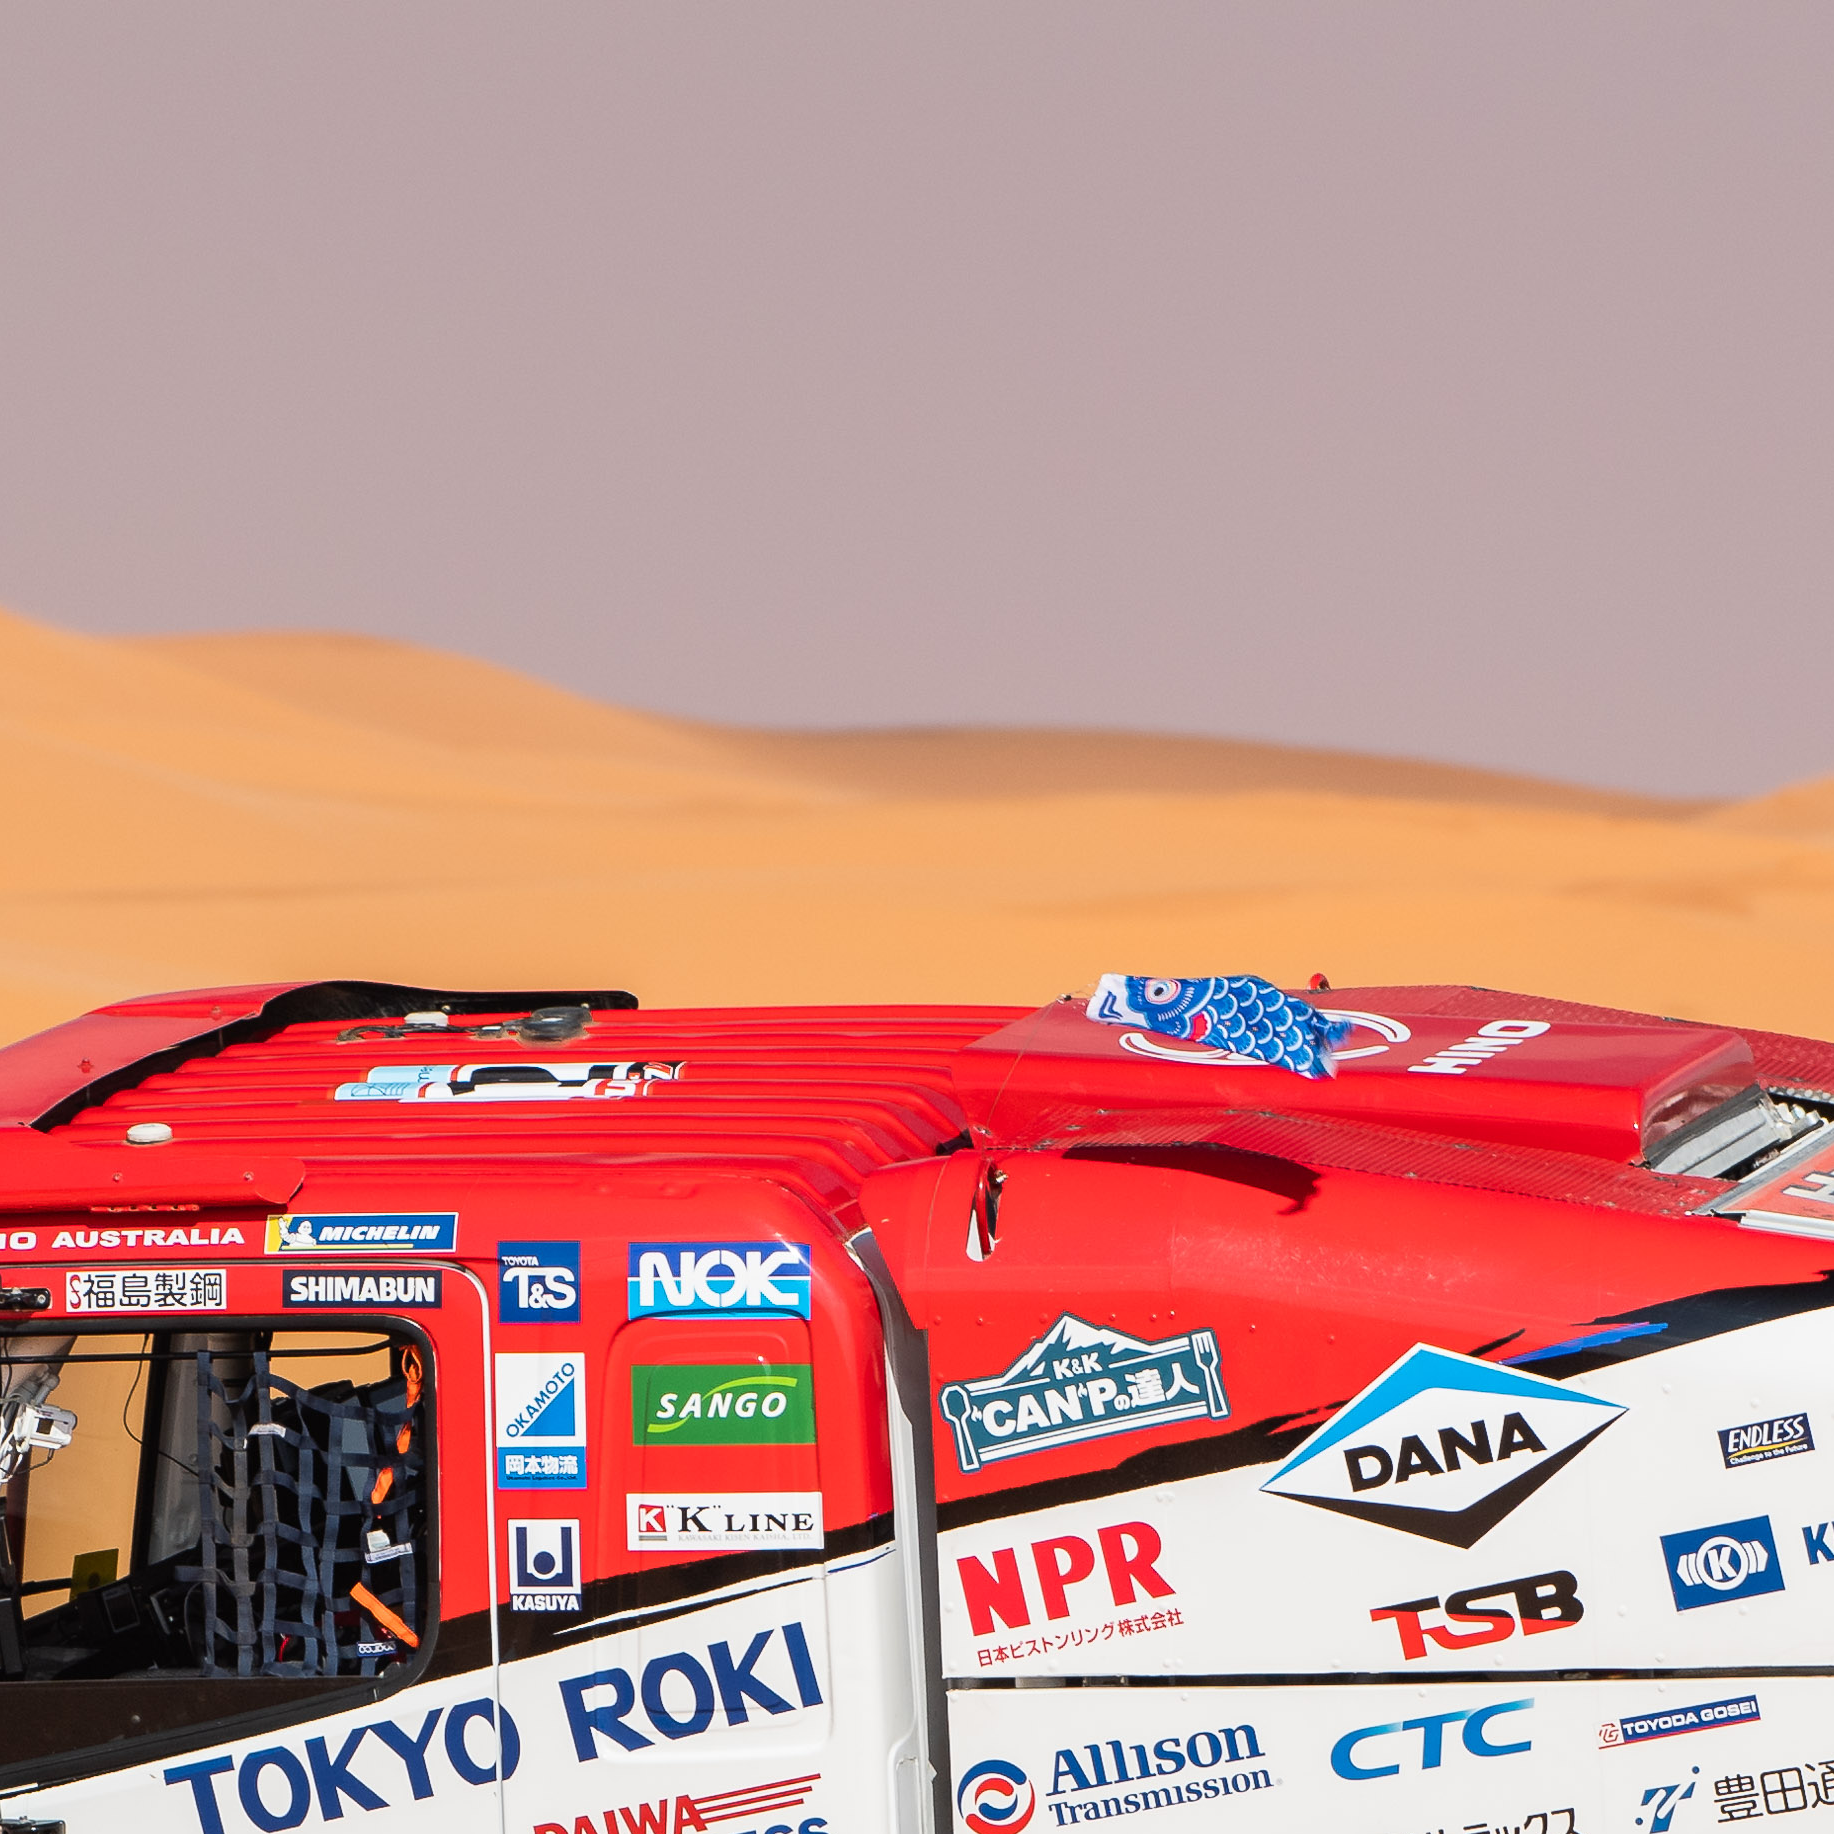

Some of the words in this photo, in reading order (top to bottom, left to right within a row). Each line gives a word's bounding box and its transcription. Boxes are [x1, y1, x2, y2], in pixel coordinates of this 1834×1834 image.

[1408, 1019, 1551, 1075] HINO
[51, 1227, 245, 1249] AUSTRALIA
[318, 1223, 441, 1241] MICHELIN
[501, 1256, 539, 1266] TOYOTA
[638, 1250, 800, 1308] NOK
[85, 1272, 223, 1310] 福島製鋼
[289, 1276, 436, 1303] SHIMABUN
[502, 1266, 577, 1310] T&S
[1052, 1351, 1103, 1380] K&K
[505, 1362, 576, 1439] OKAMOTO
[655, 1391, 788, 1420] SANGO
[1342, 1410, 1548, 1493] DANA
[1727, 1416, 1805, 1454] ENDLESS
[505, 1454, 579, 1476] 岡本物流
[956, 1521, 1177, 1637] NPR
[511, 1594, 581, 1612] KASUYA
[1370, 1569, 1585, 1661] TSB
[976, 1608, 1186, 1668] 日本ピストンリング株式会社
[558, 1620, 825, 1764] ROKI
[1329, 1696, 1536, 1782] CTC
[1622, 1710, 1698, 1736] TOYODA
[1699, 1700, 1758, 1723] GOSEI
[1044, 1722, 1267, 1798] Allison
[1047, 1765, 1275, 1828] Transmission
